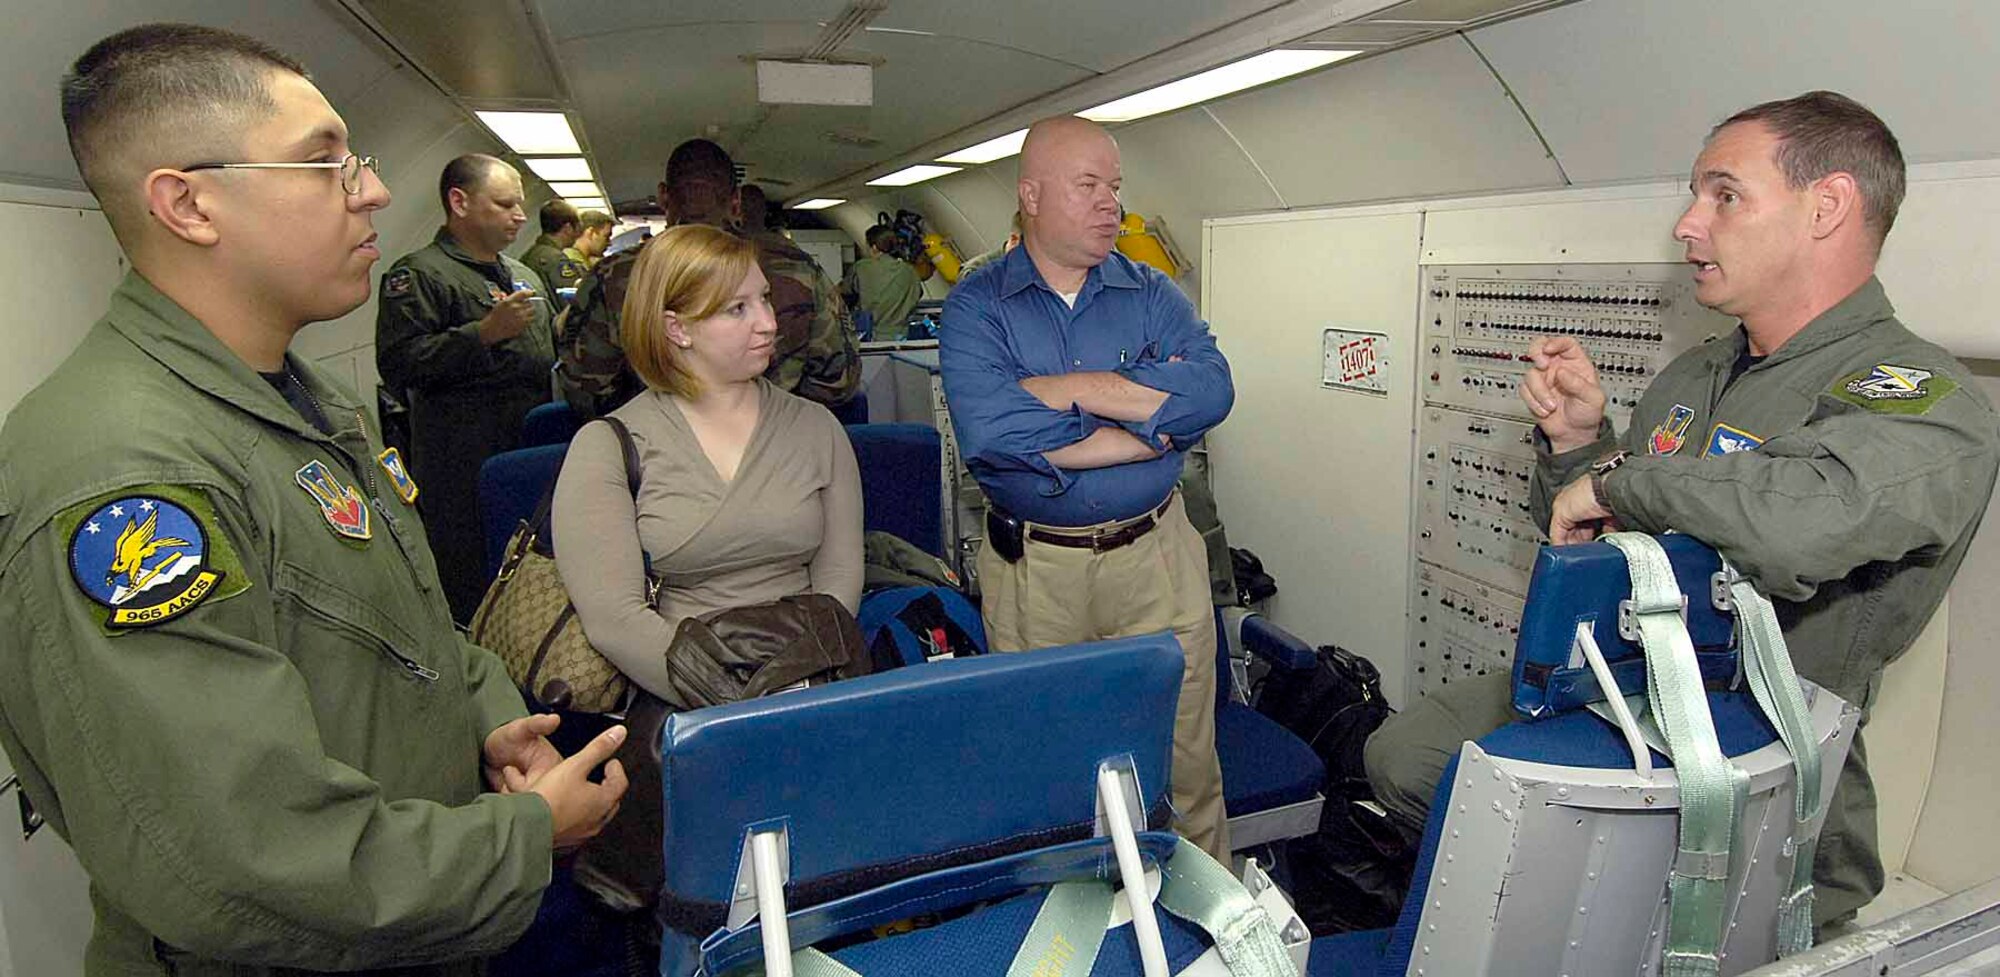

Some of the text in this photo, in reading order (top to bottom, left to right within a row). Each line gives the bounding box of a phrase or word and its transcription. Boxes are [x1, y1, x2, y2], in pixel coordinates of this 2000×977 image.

[1345, 347, 1369, 372] 1407
[126, 579, 210, 621] 965 AACS
